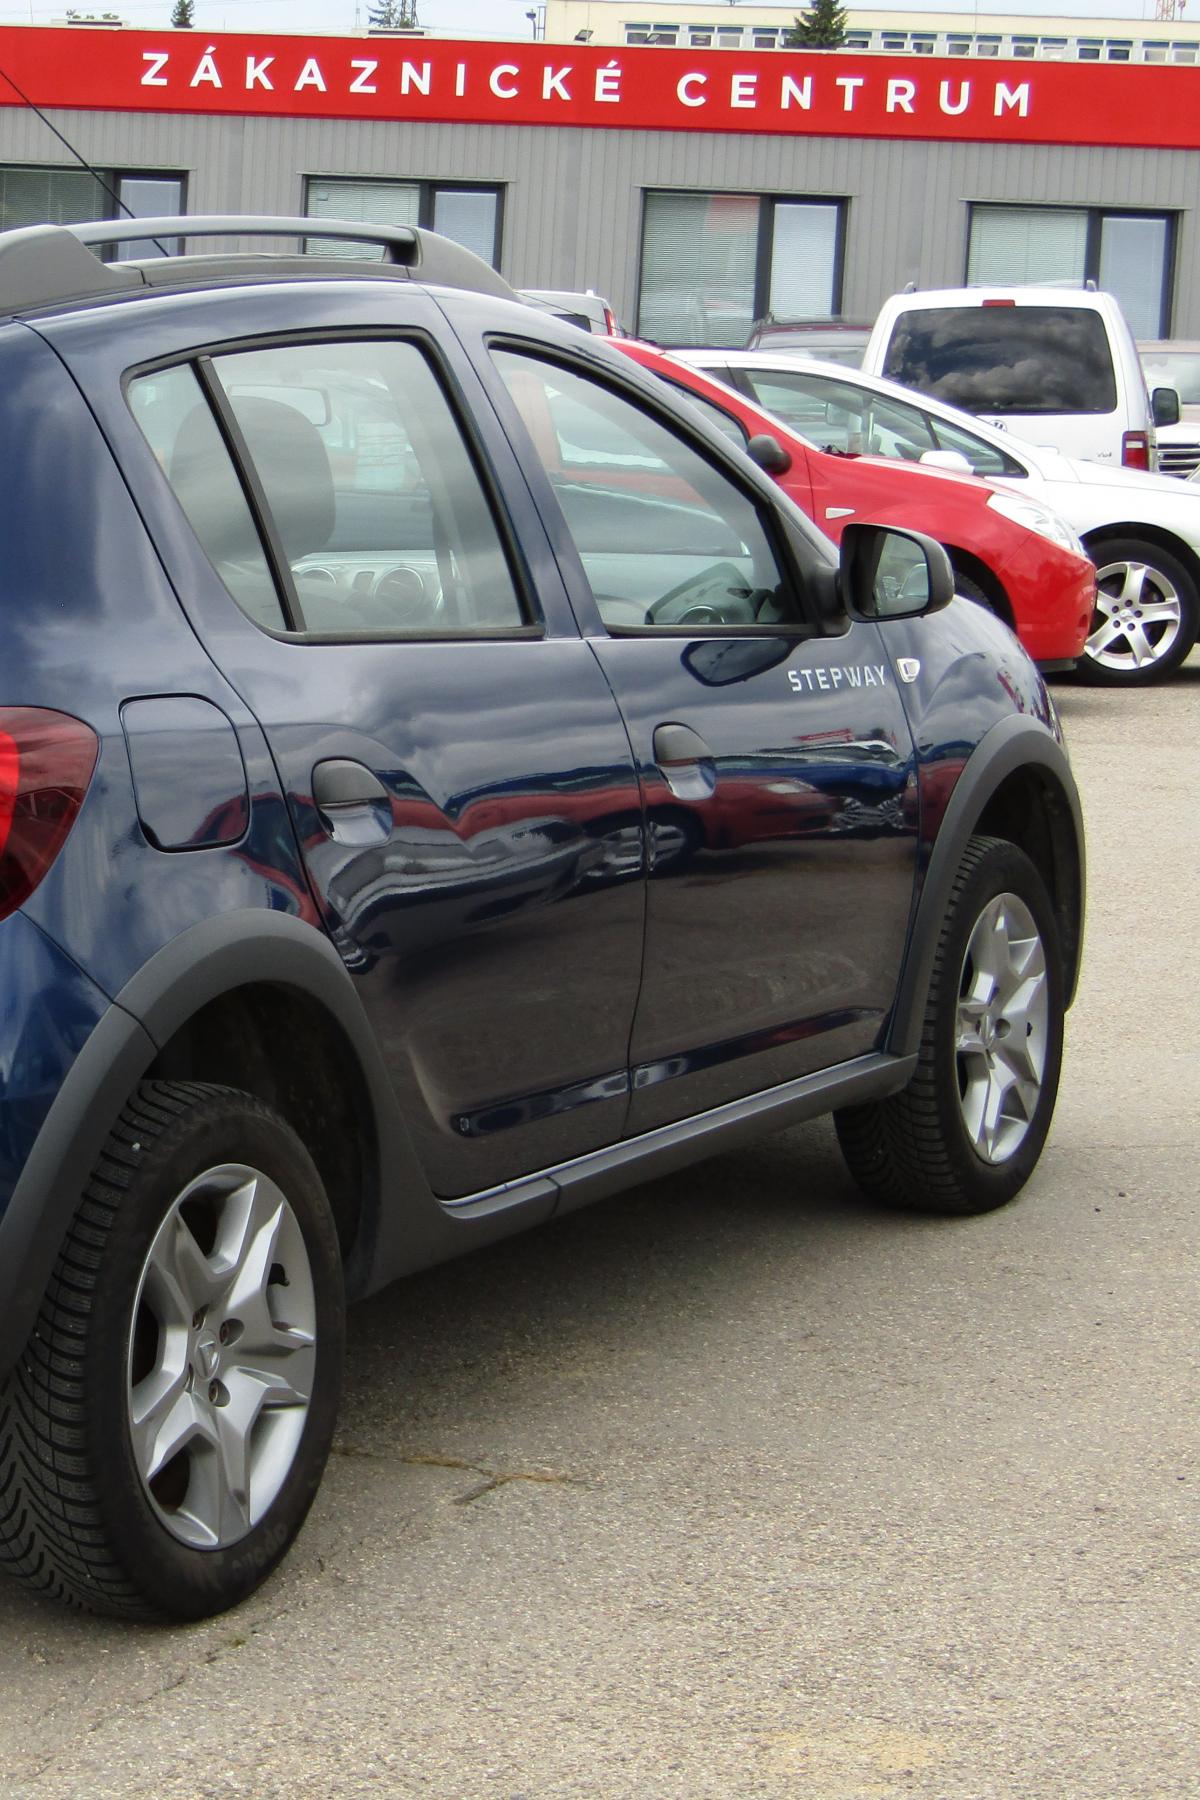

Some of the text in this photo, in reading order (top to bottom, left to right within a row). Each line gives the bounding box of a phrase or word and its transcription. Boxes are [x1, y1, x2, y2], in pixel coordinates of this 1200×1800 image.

[141, 46, 1030, 117] ZÁKAZNICKÉ CENTRUM
[787, 665, 885, 692] STEPWAY
